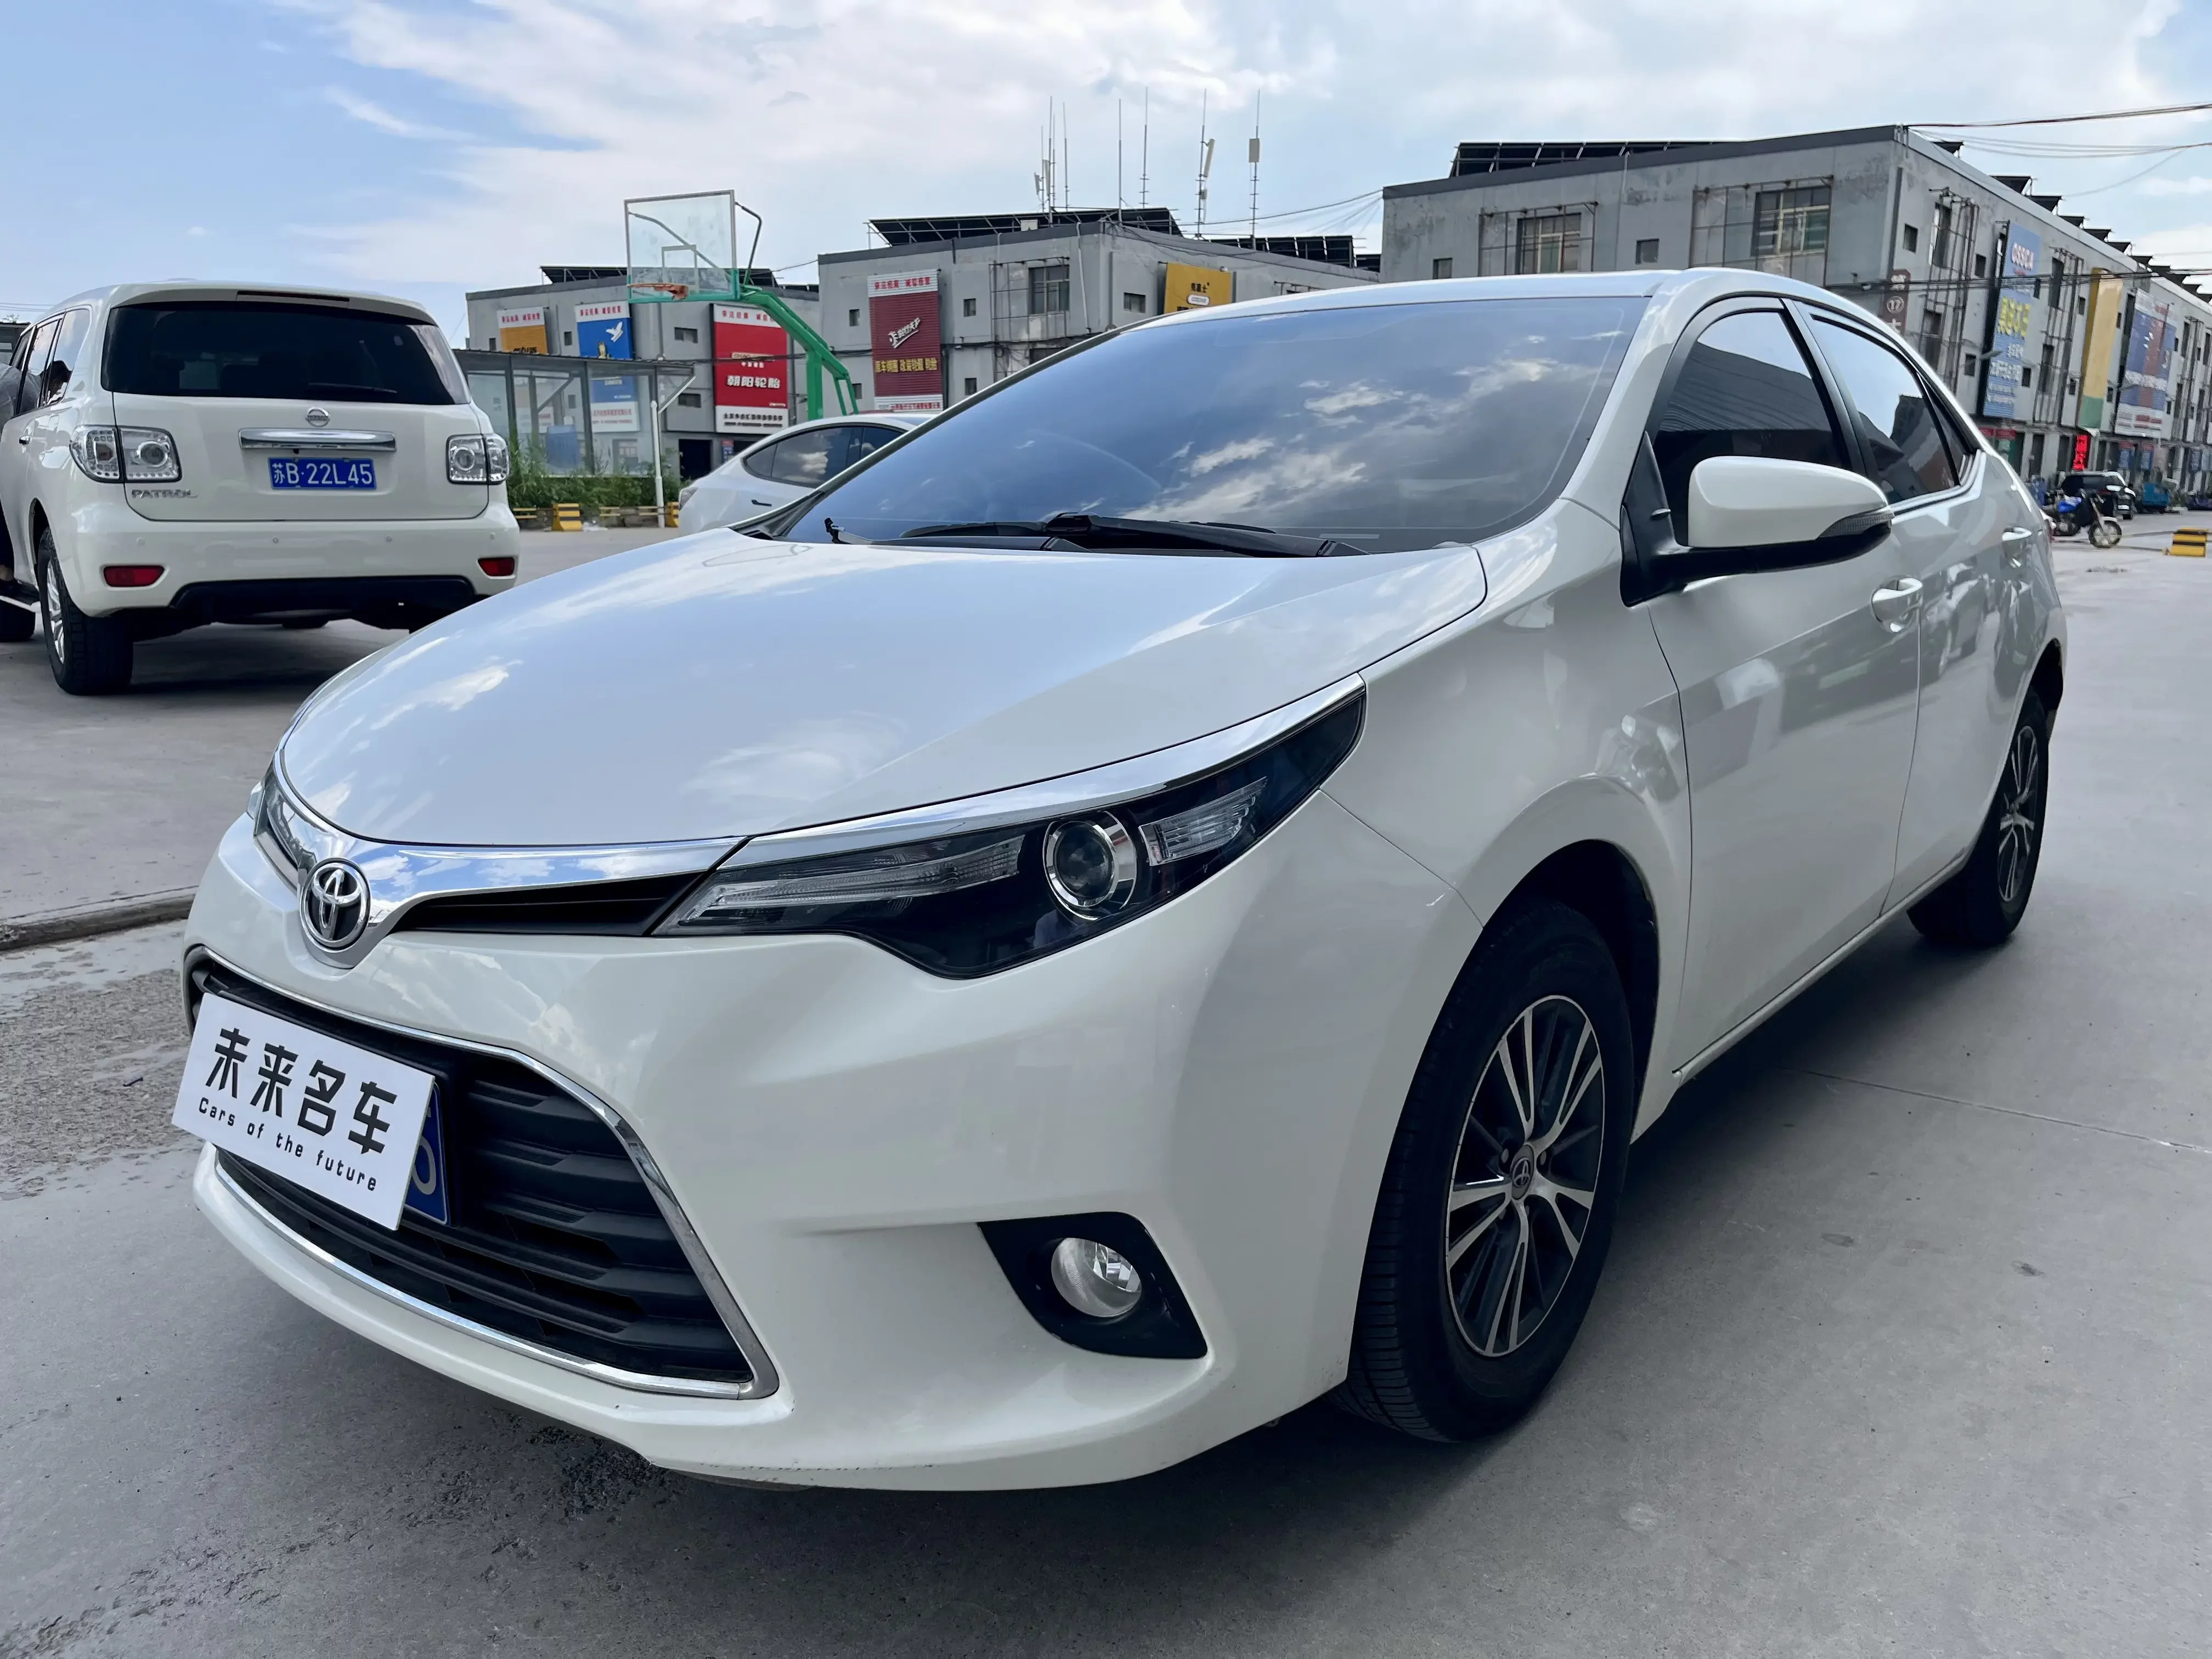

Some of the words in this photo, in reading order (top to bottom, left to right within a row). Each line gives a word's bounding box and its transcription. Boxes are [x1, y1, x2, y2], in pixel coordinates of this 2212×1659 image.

[727, 375, 780, 389] 朝阳轮胎
[131, 489, 198, 498] PATROL
[205, 1028, 398, 1154] 未来名车
[199, 1097, 235, 1126] Cars
[247, 1122, 264, 1139] of
[276, 1132, 303, 1158] the
[316, 1150, 376, 1191] future
